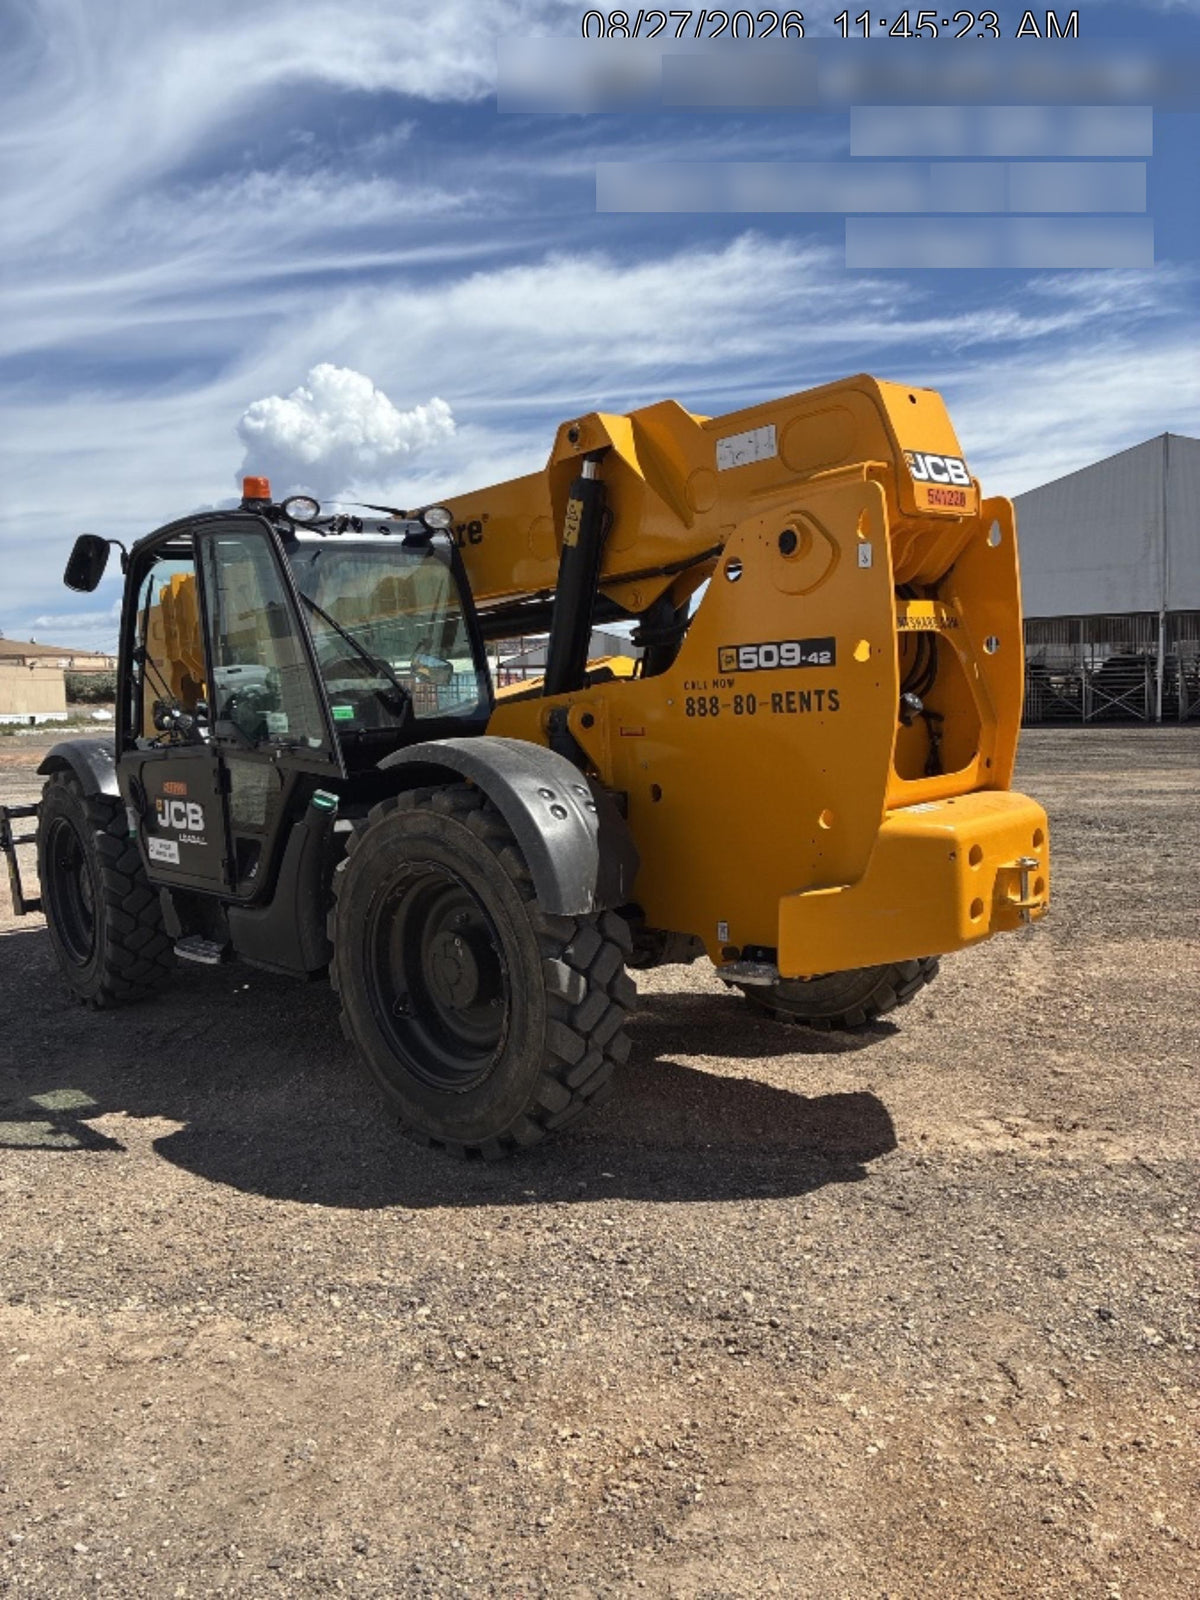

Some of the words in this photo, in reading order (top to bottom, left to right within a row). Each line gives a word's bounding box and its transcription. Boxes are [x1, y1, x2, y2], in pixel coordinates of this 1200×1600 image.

[909, 453, 970, 485] JCB
[712, 678, 735, 689] NOW
[157, 800, 205, 831] JCB
